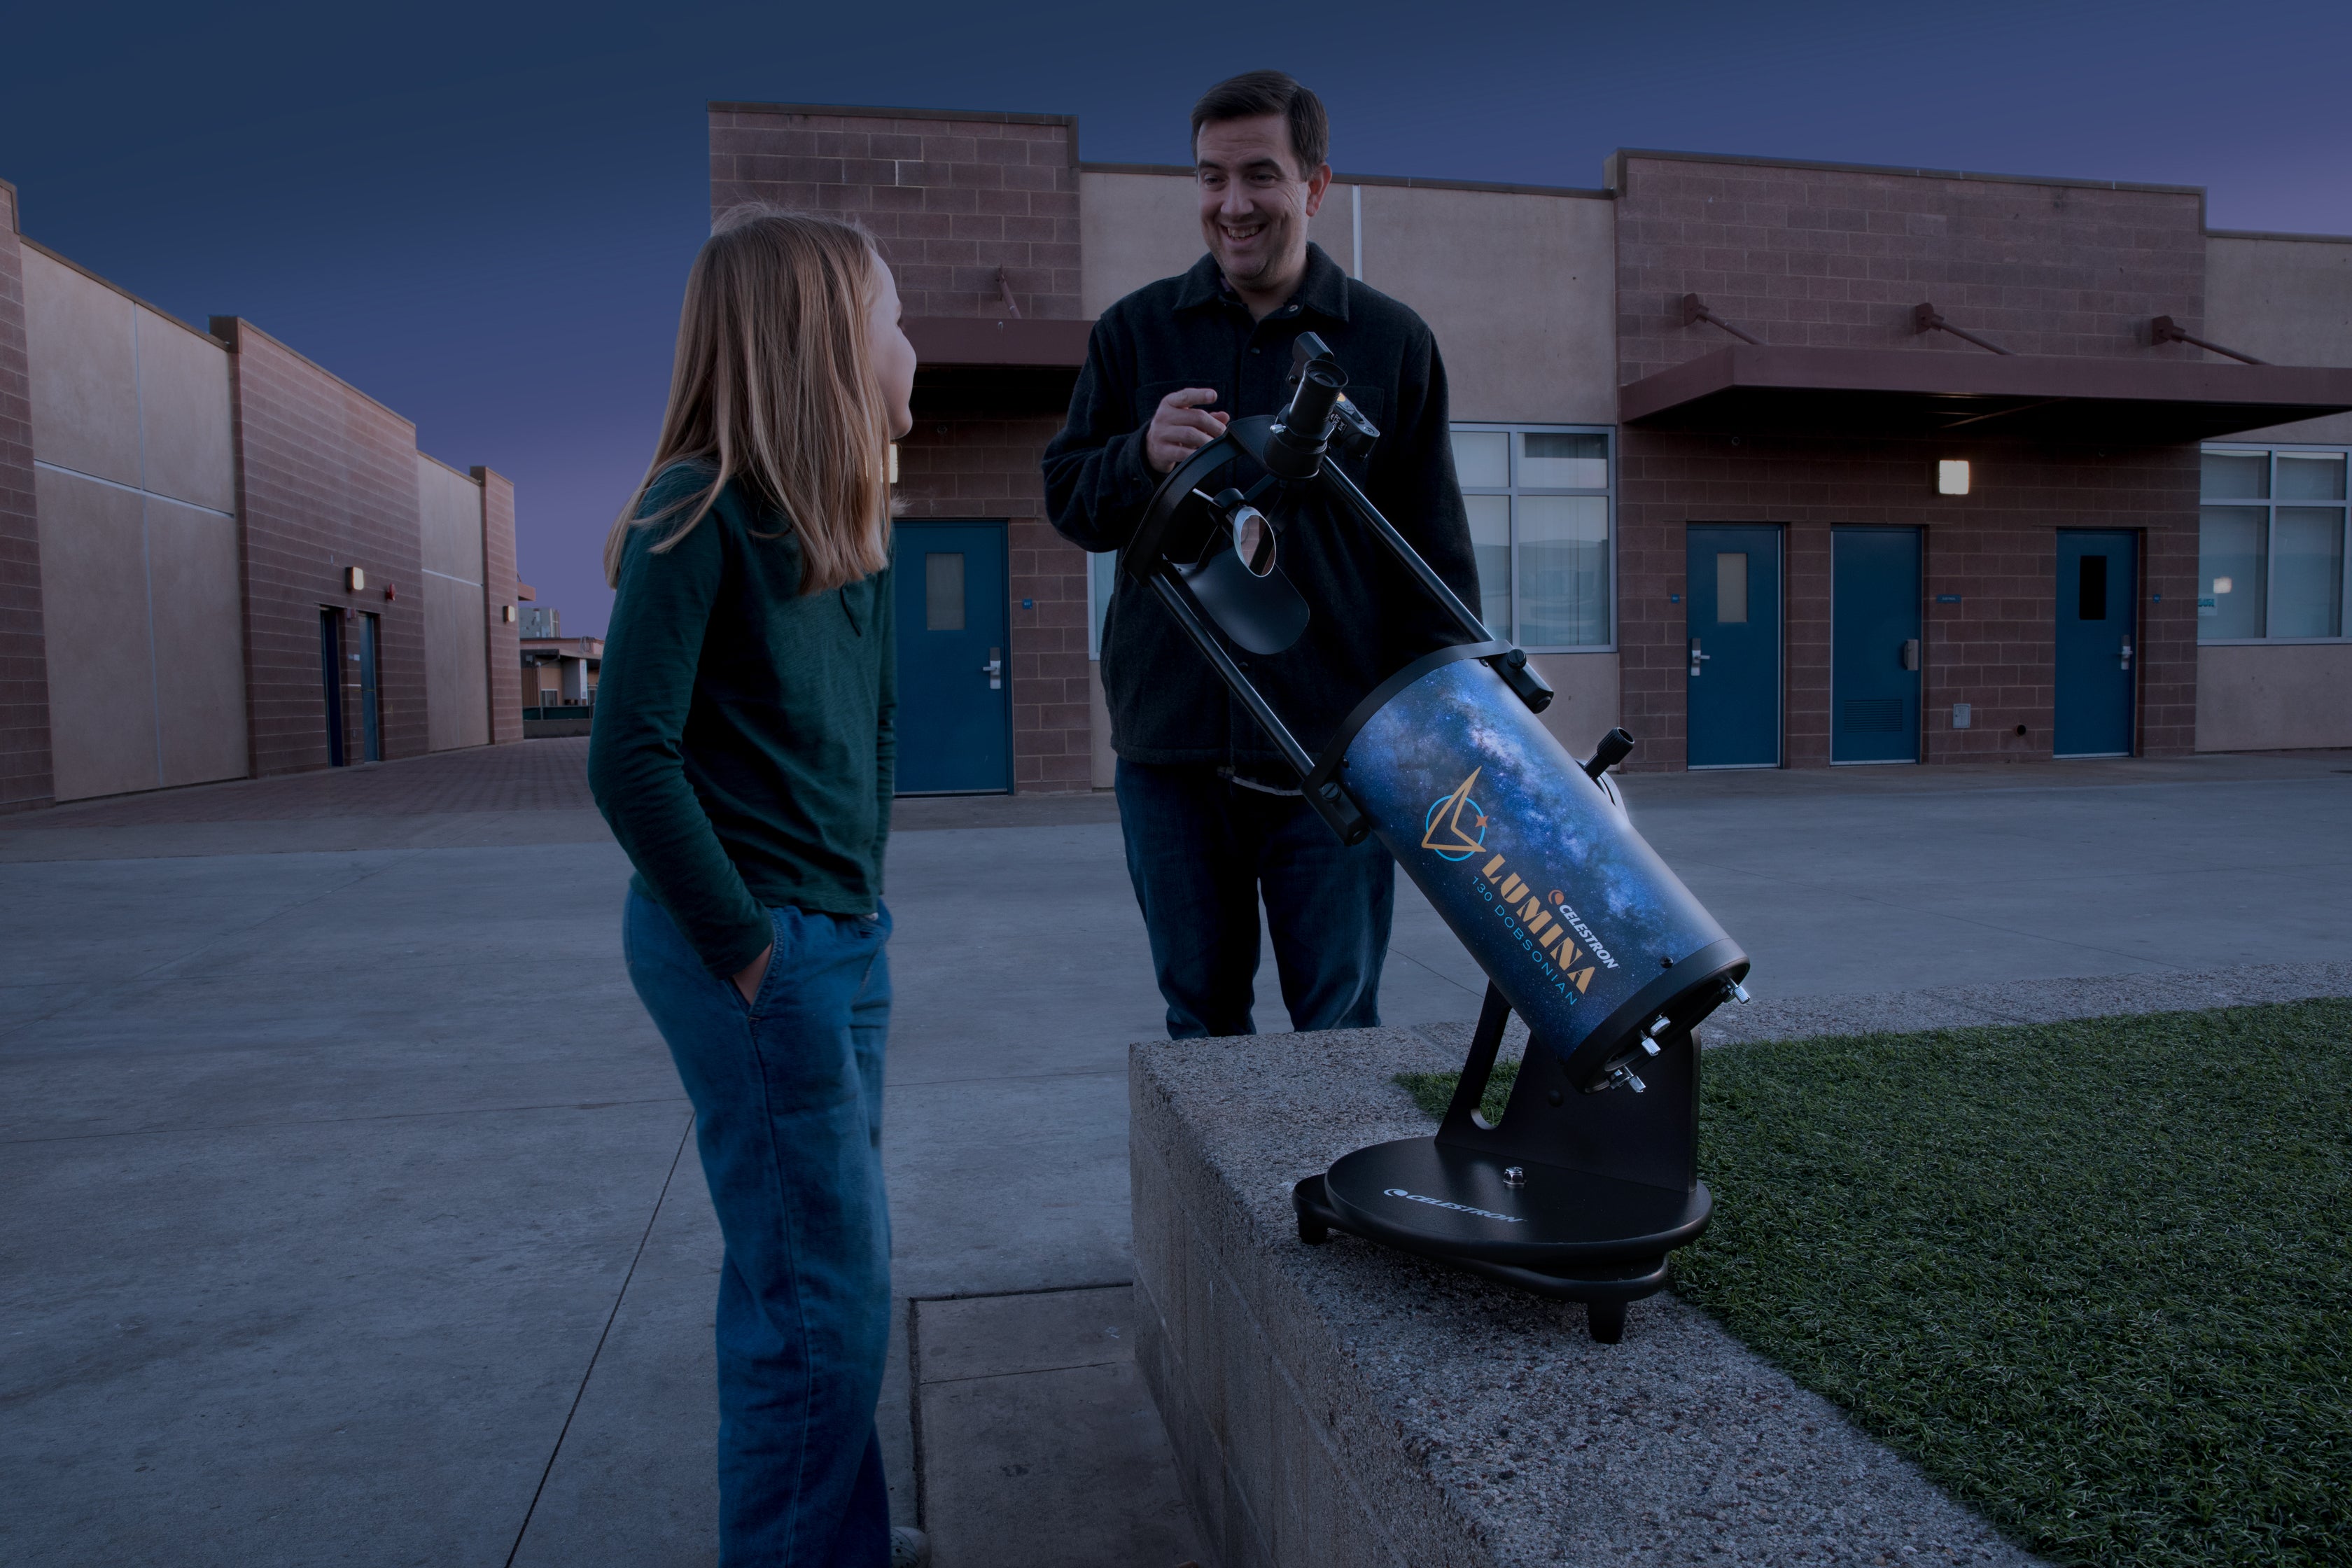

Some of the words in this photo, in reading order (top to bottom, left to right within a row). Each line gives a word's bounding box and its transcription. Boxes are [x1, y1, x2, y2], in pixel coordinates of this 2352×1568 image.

[1472, 876, 1493, 902] 130
[1494, 904, 1578, 1006] DOBSONIAN
[1482, 853, 1596, 995] LUMINA
[1559, 904, 1619, 969] CELESTRON
[1406, 1195, 1524, 1222] CELESTRON
